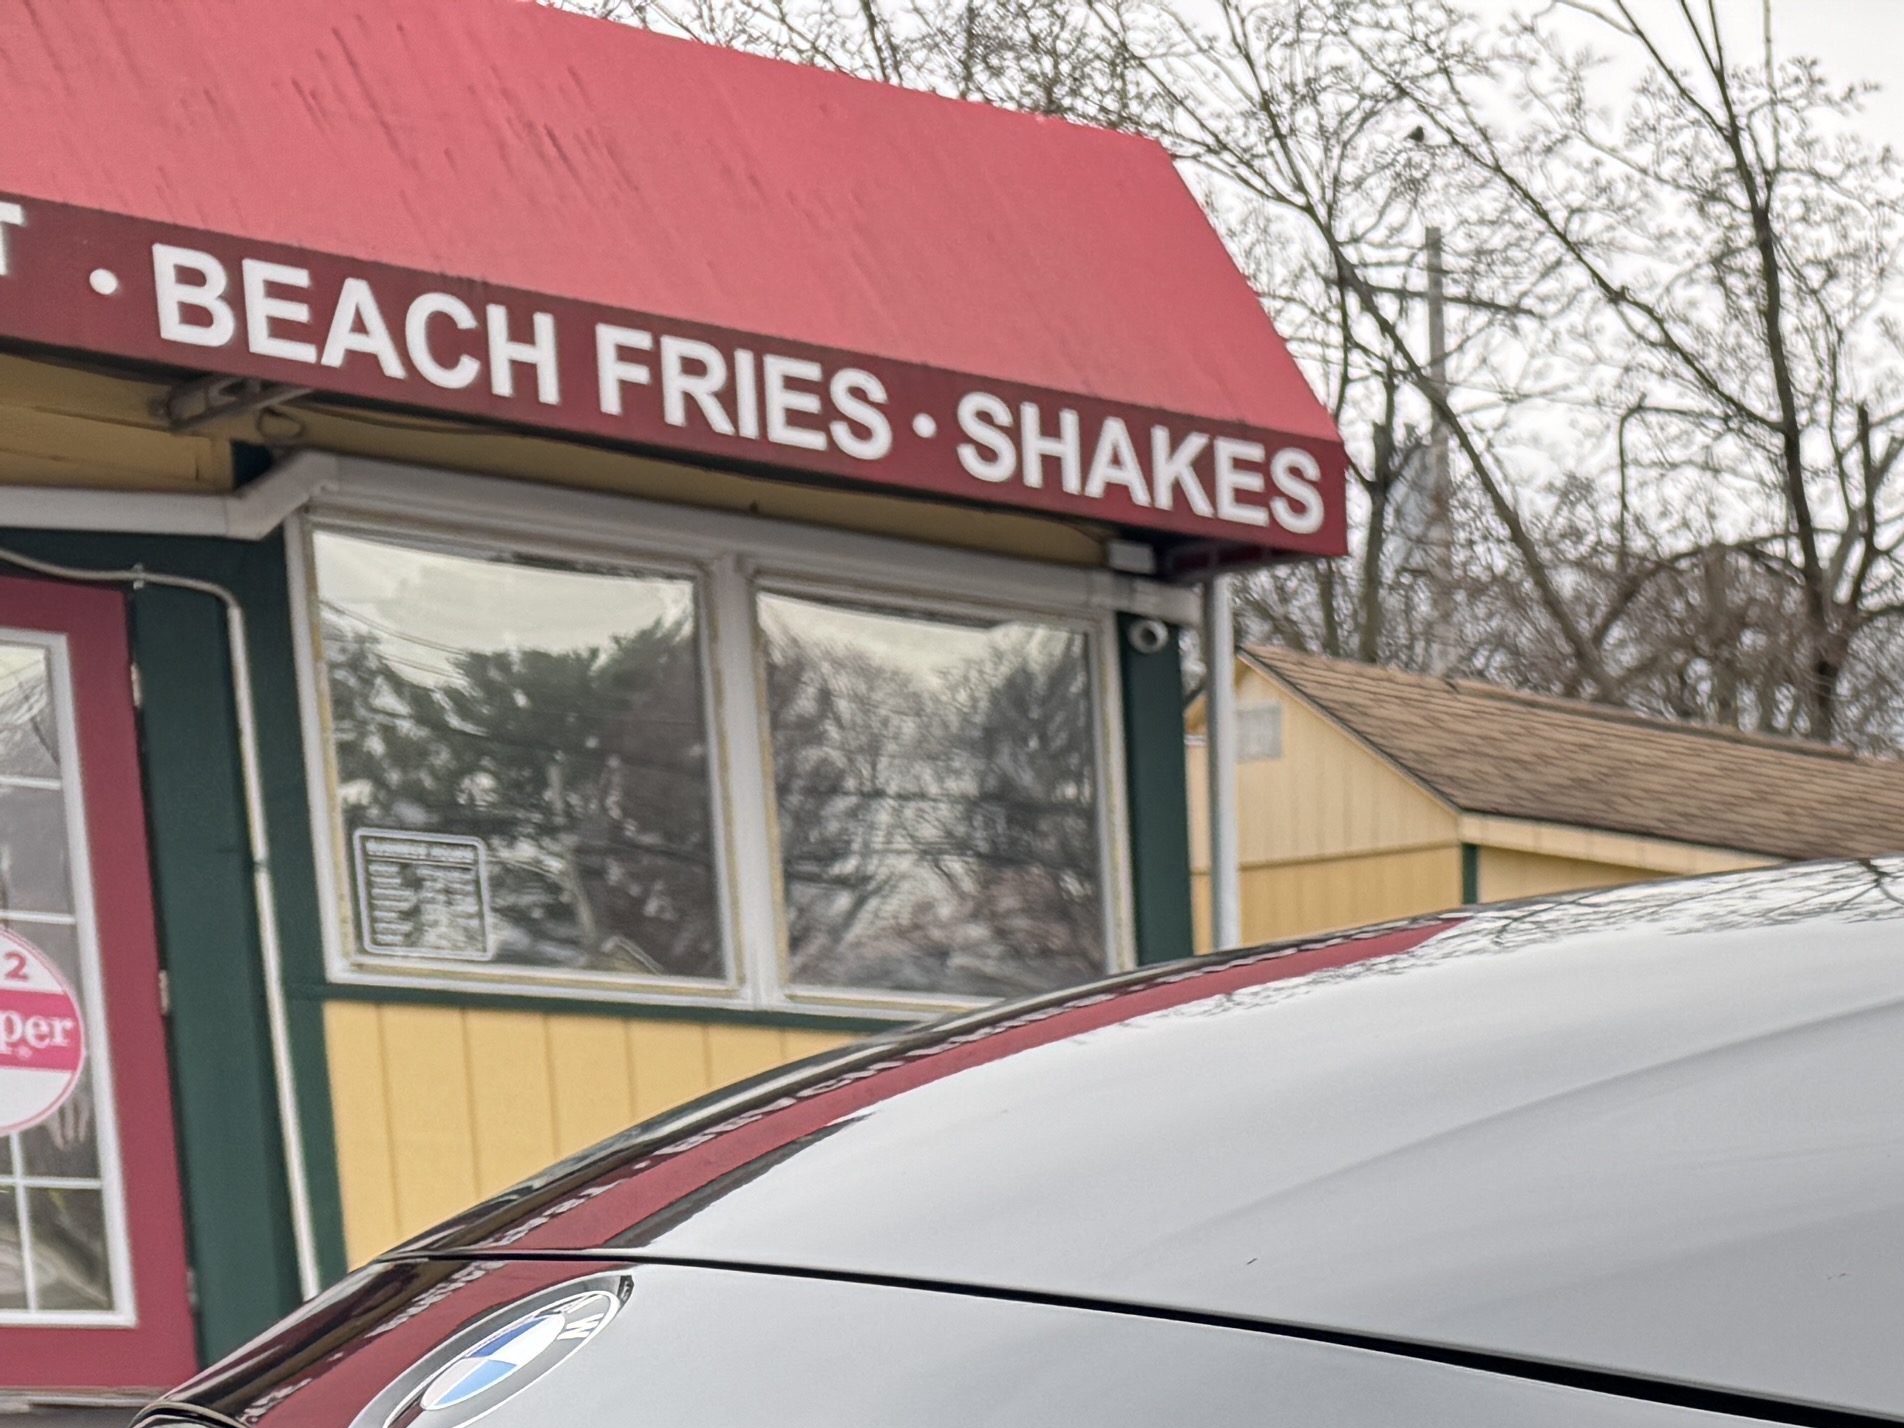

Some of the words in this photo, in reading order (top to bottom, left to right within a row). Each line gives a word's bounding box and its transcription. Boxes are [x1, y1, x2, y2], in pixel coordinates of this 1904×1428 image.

[152, 243, 561, 405] BEACH
[595, 322, 893, 460] FRIES
[956, 391, 1325, 534] SHAKES
[4, 952, 30, 981] 2
